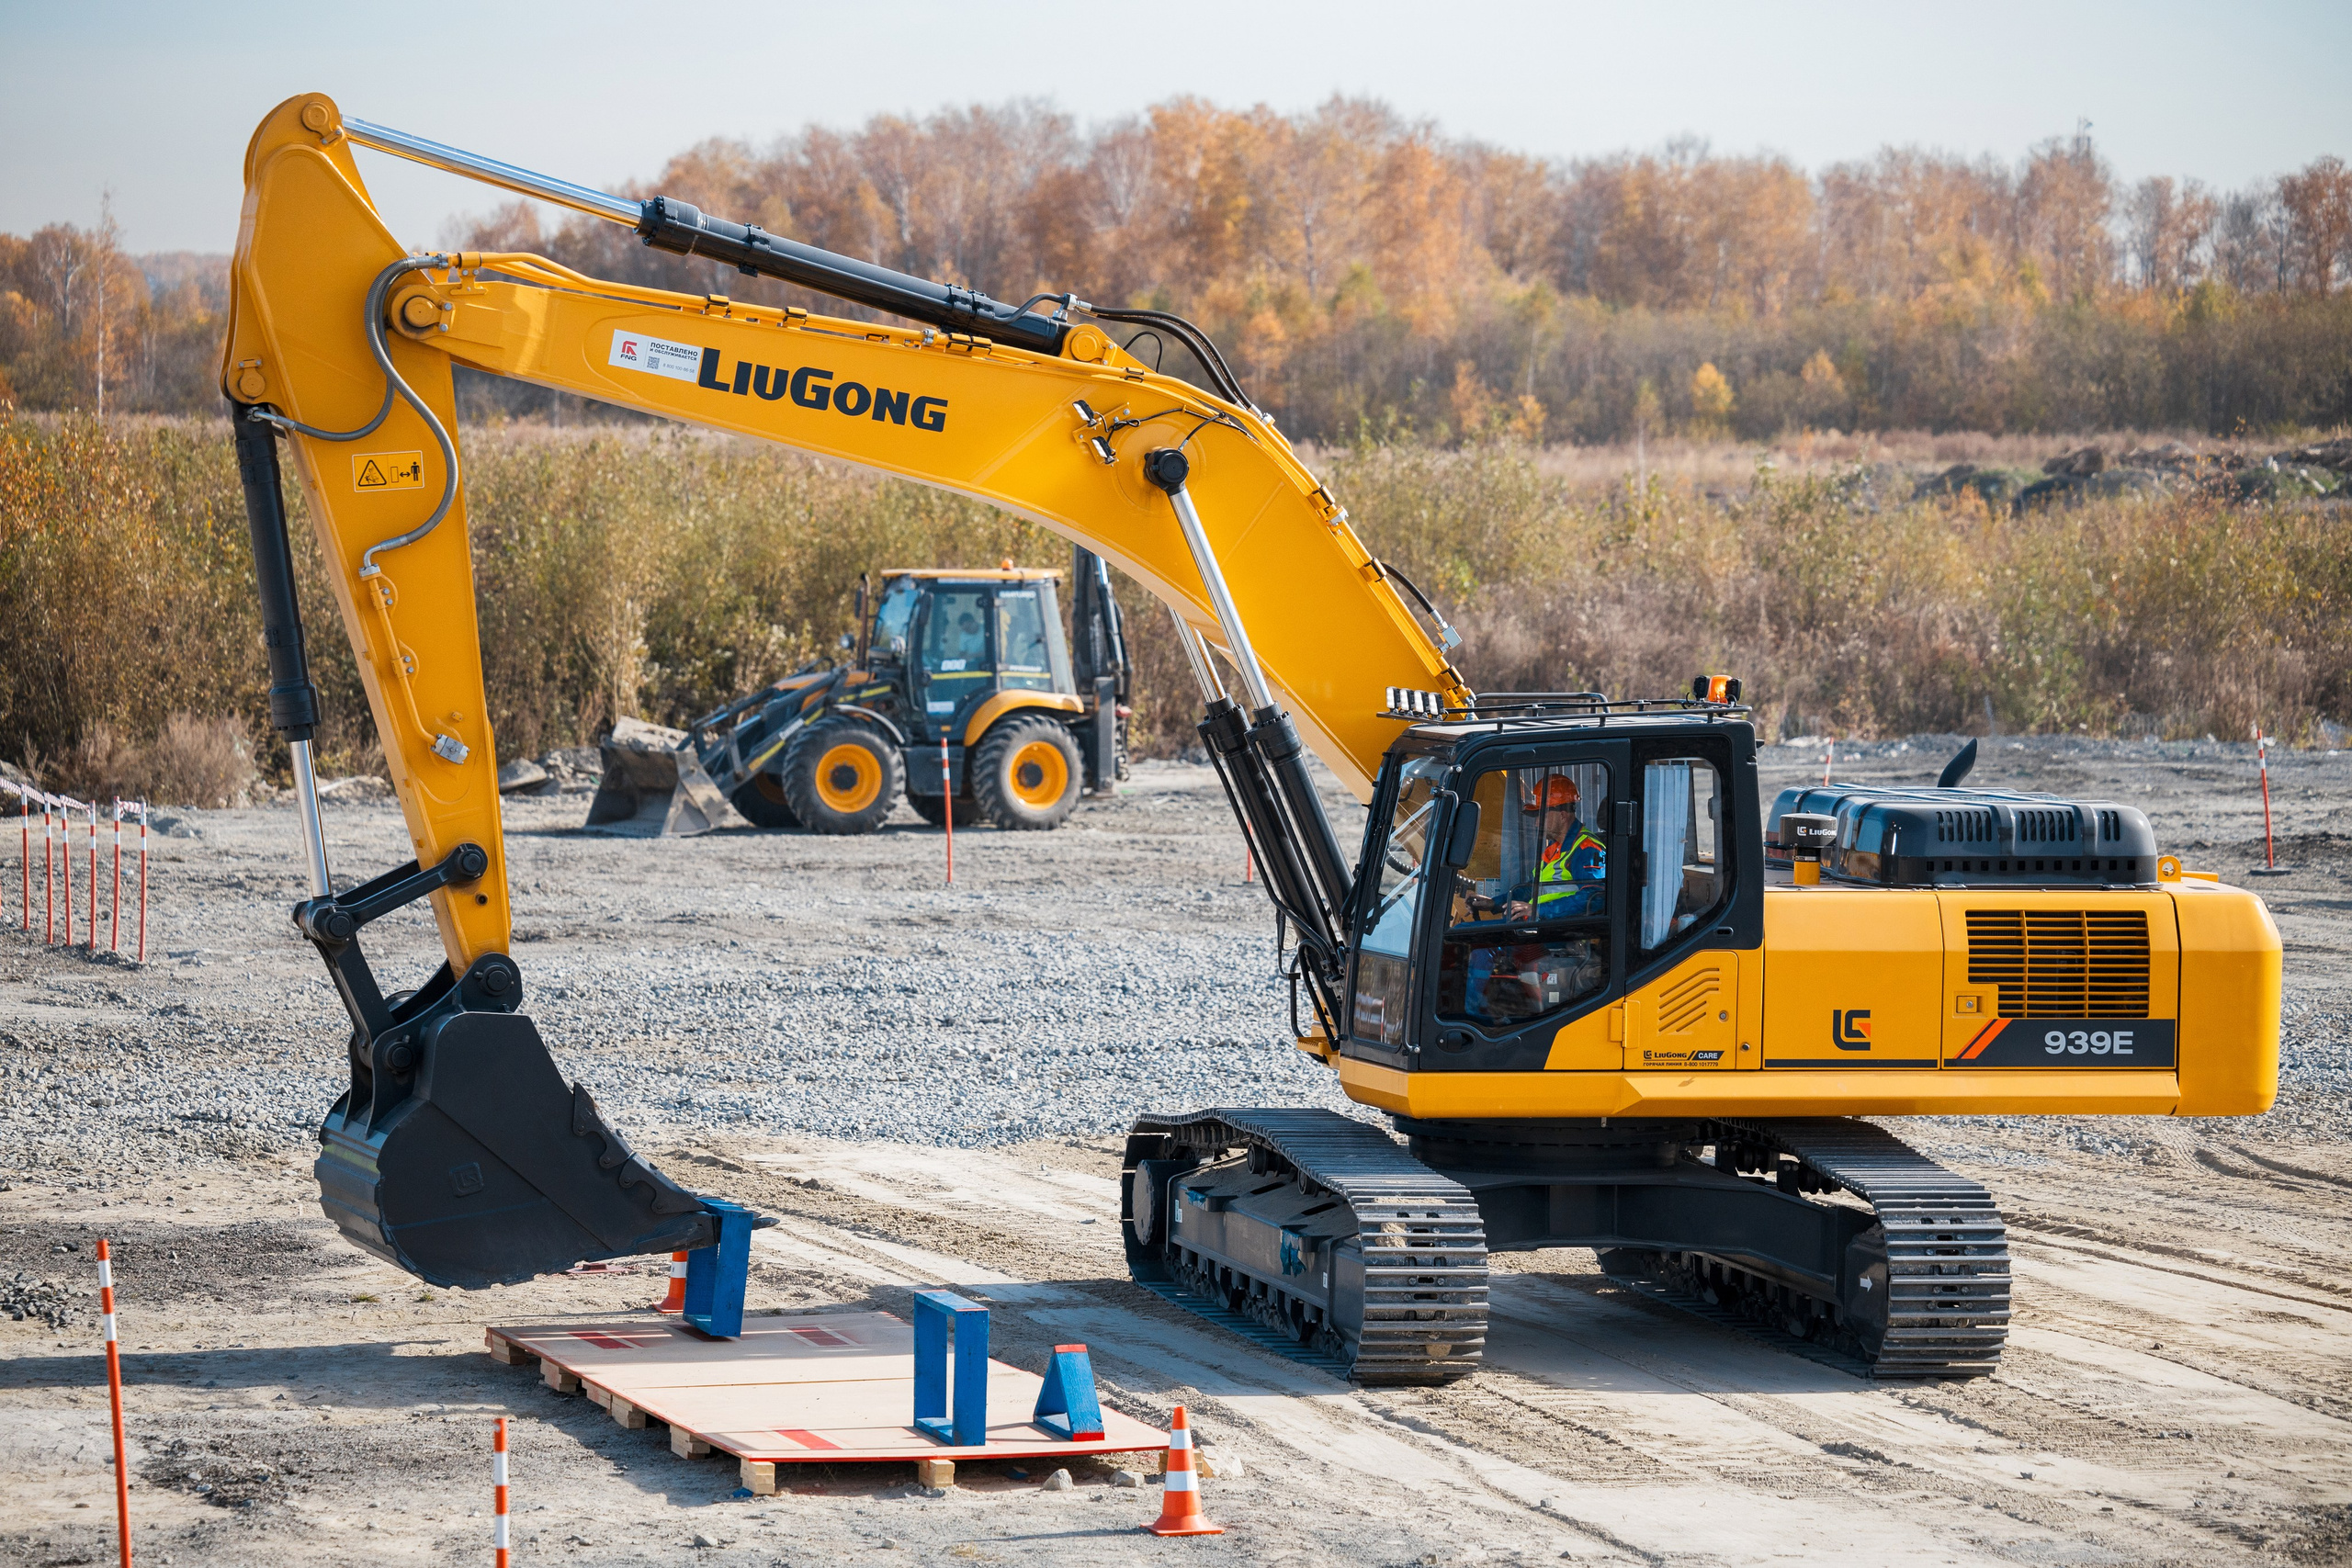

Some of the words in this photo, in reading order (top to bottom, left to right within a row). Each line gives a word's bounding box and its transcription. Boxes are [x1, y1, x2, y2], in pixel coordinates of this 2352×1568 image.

[650, 342, 698, 357] ПОСТАВЛЕНО
[654, 348, 697, 361] ОБСЛУЖИВАЕТСЯ
[620, 353, 638, 362] FNG
[2044, 1031, 2133, 1055] 939E
